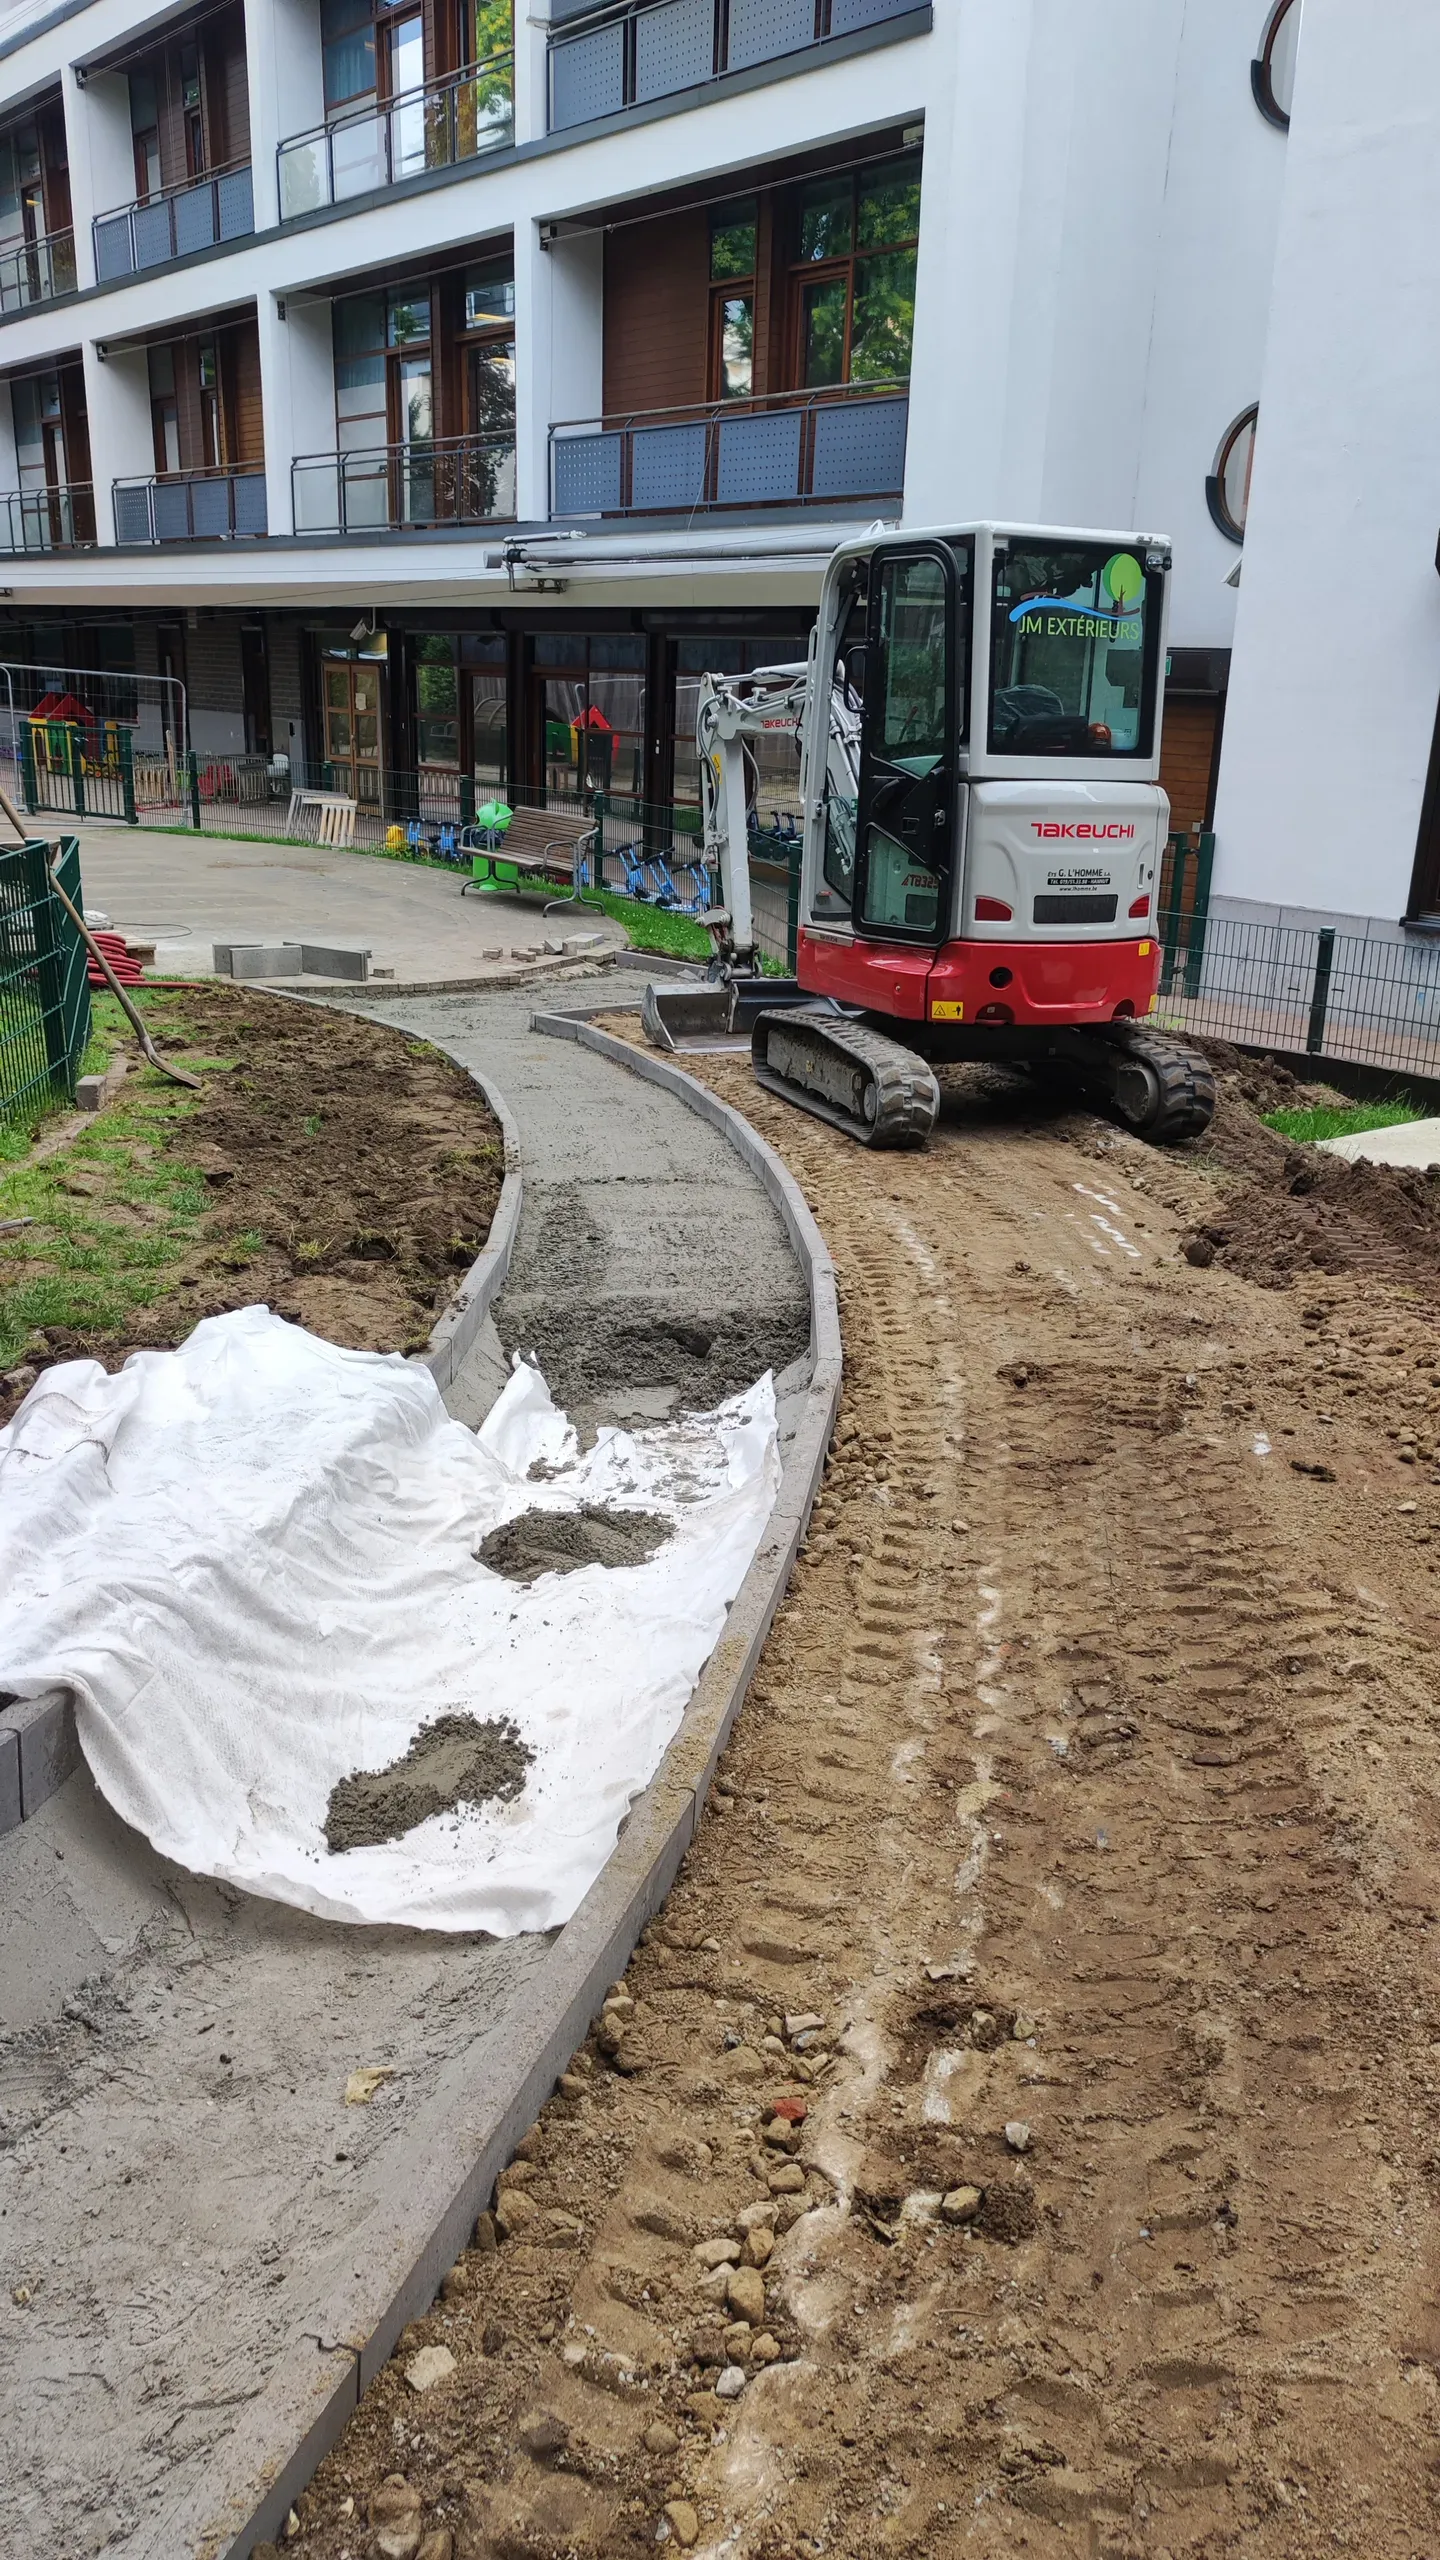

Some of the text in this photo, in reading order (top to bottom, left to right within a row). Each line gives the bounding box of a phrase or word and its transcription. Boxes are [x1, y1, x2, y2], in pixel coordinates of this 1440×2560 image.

[1019, 615, 1140, 640] JM EXTÉRIEURS
[1031, 823, 1135, 838] TAKEUCHI
[1058, 868, 1066, 877] G.
[1068, 868, 1103, 877] L'HOMME
